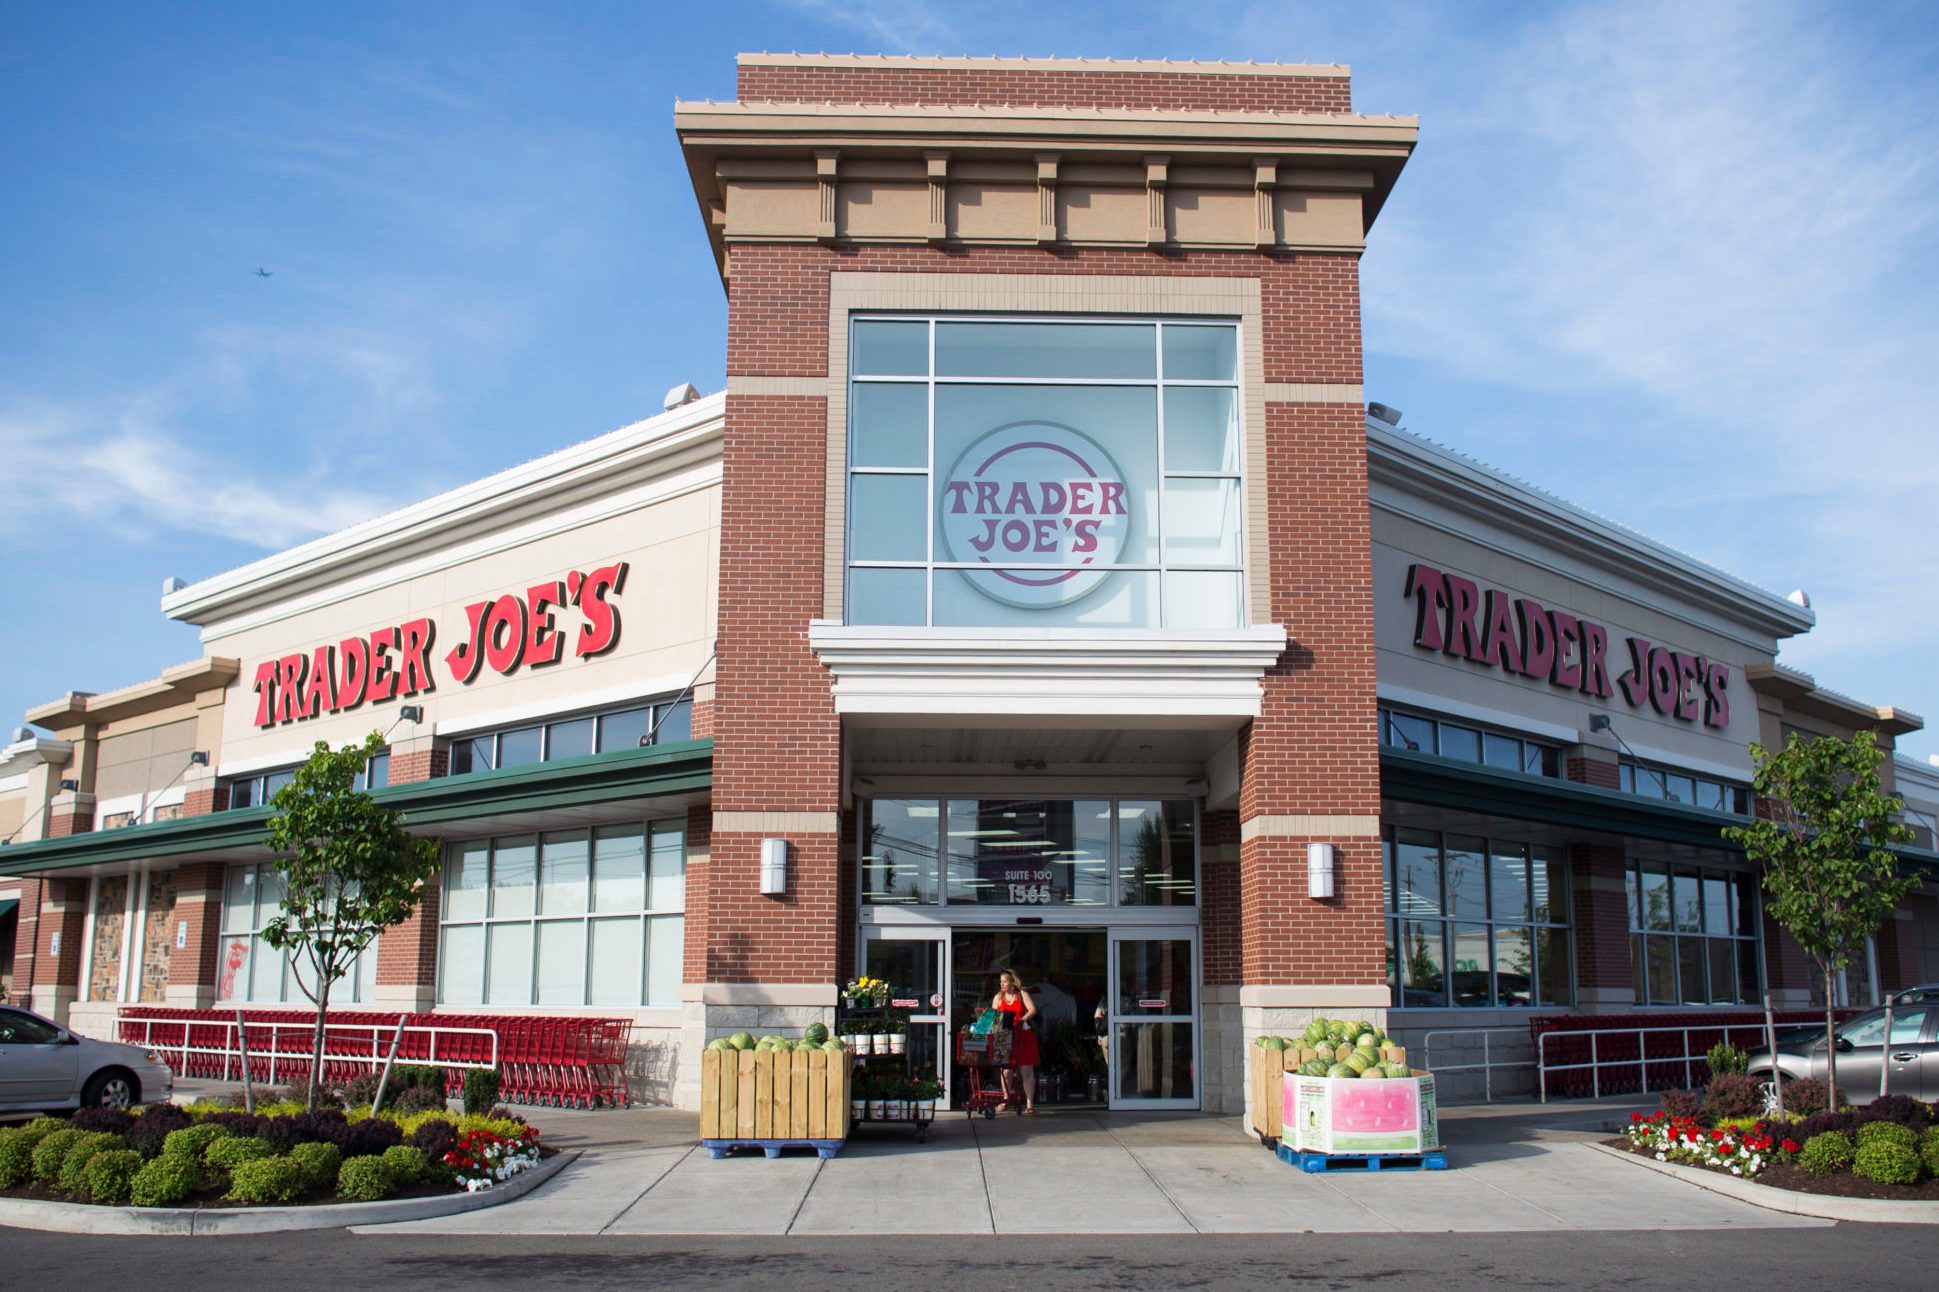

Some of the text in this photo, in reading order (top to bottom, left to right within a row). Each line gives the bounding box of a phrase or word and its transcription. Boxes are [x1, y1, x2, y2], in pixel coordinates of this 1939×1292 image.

[944, 481, 1128, 515] TRADER
[968, 517, 1103, 553] JOE'S
[253, 561, 630, 729] TRADER JOE'S
[1404, 563, 1731, 728] TRADER JOE'S
[1005, 870, 1053, 880] SUITE 100
[1008, 884, 1051, 904] 1565
